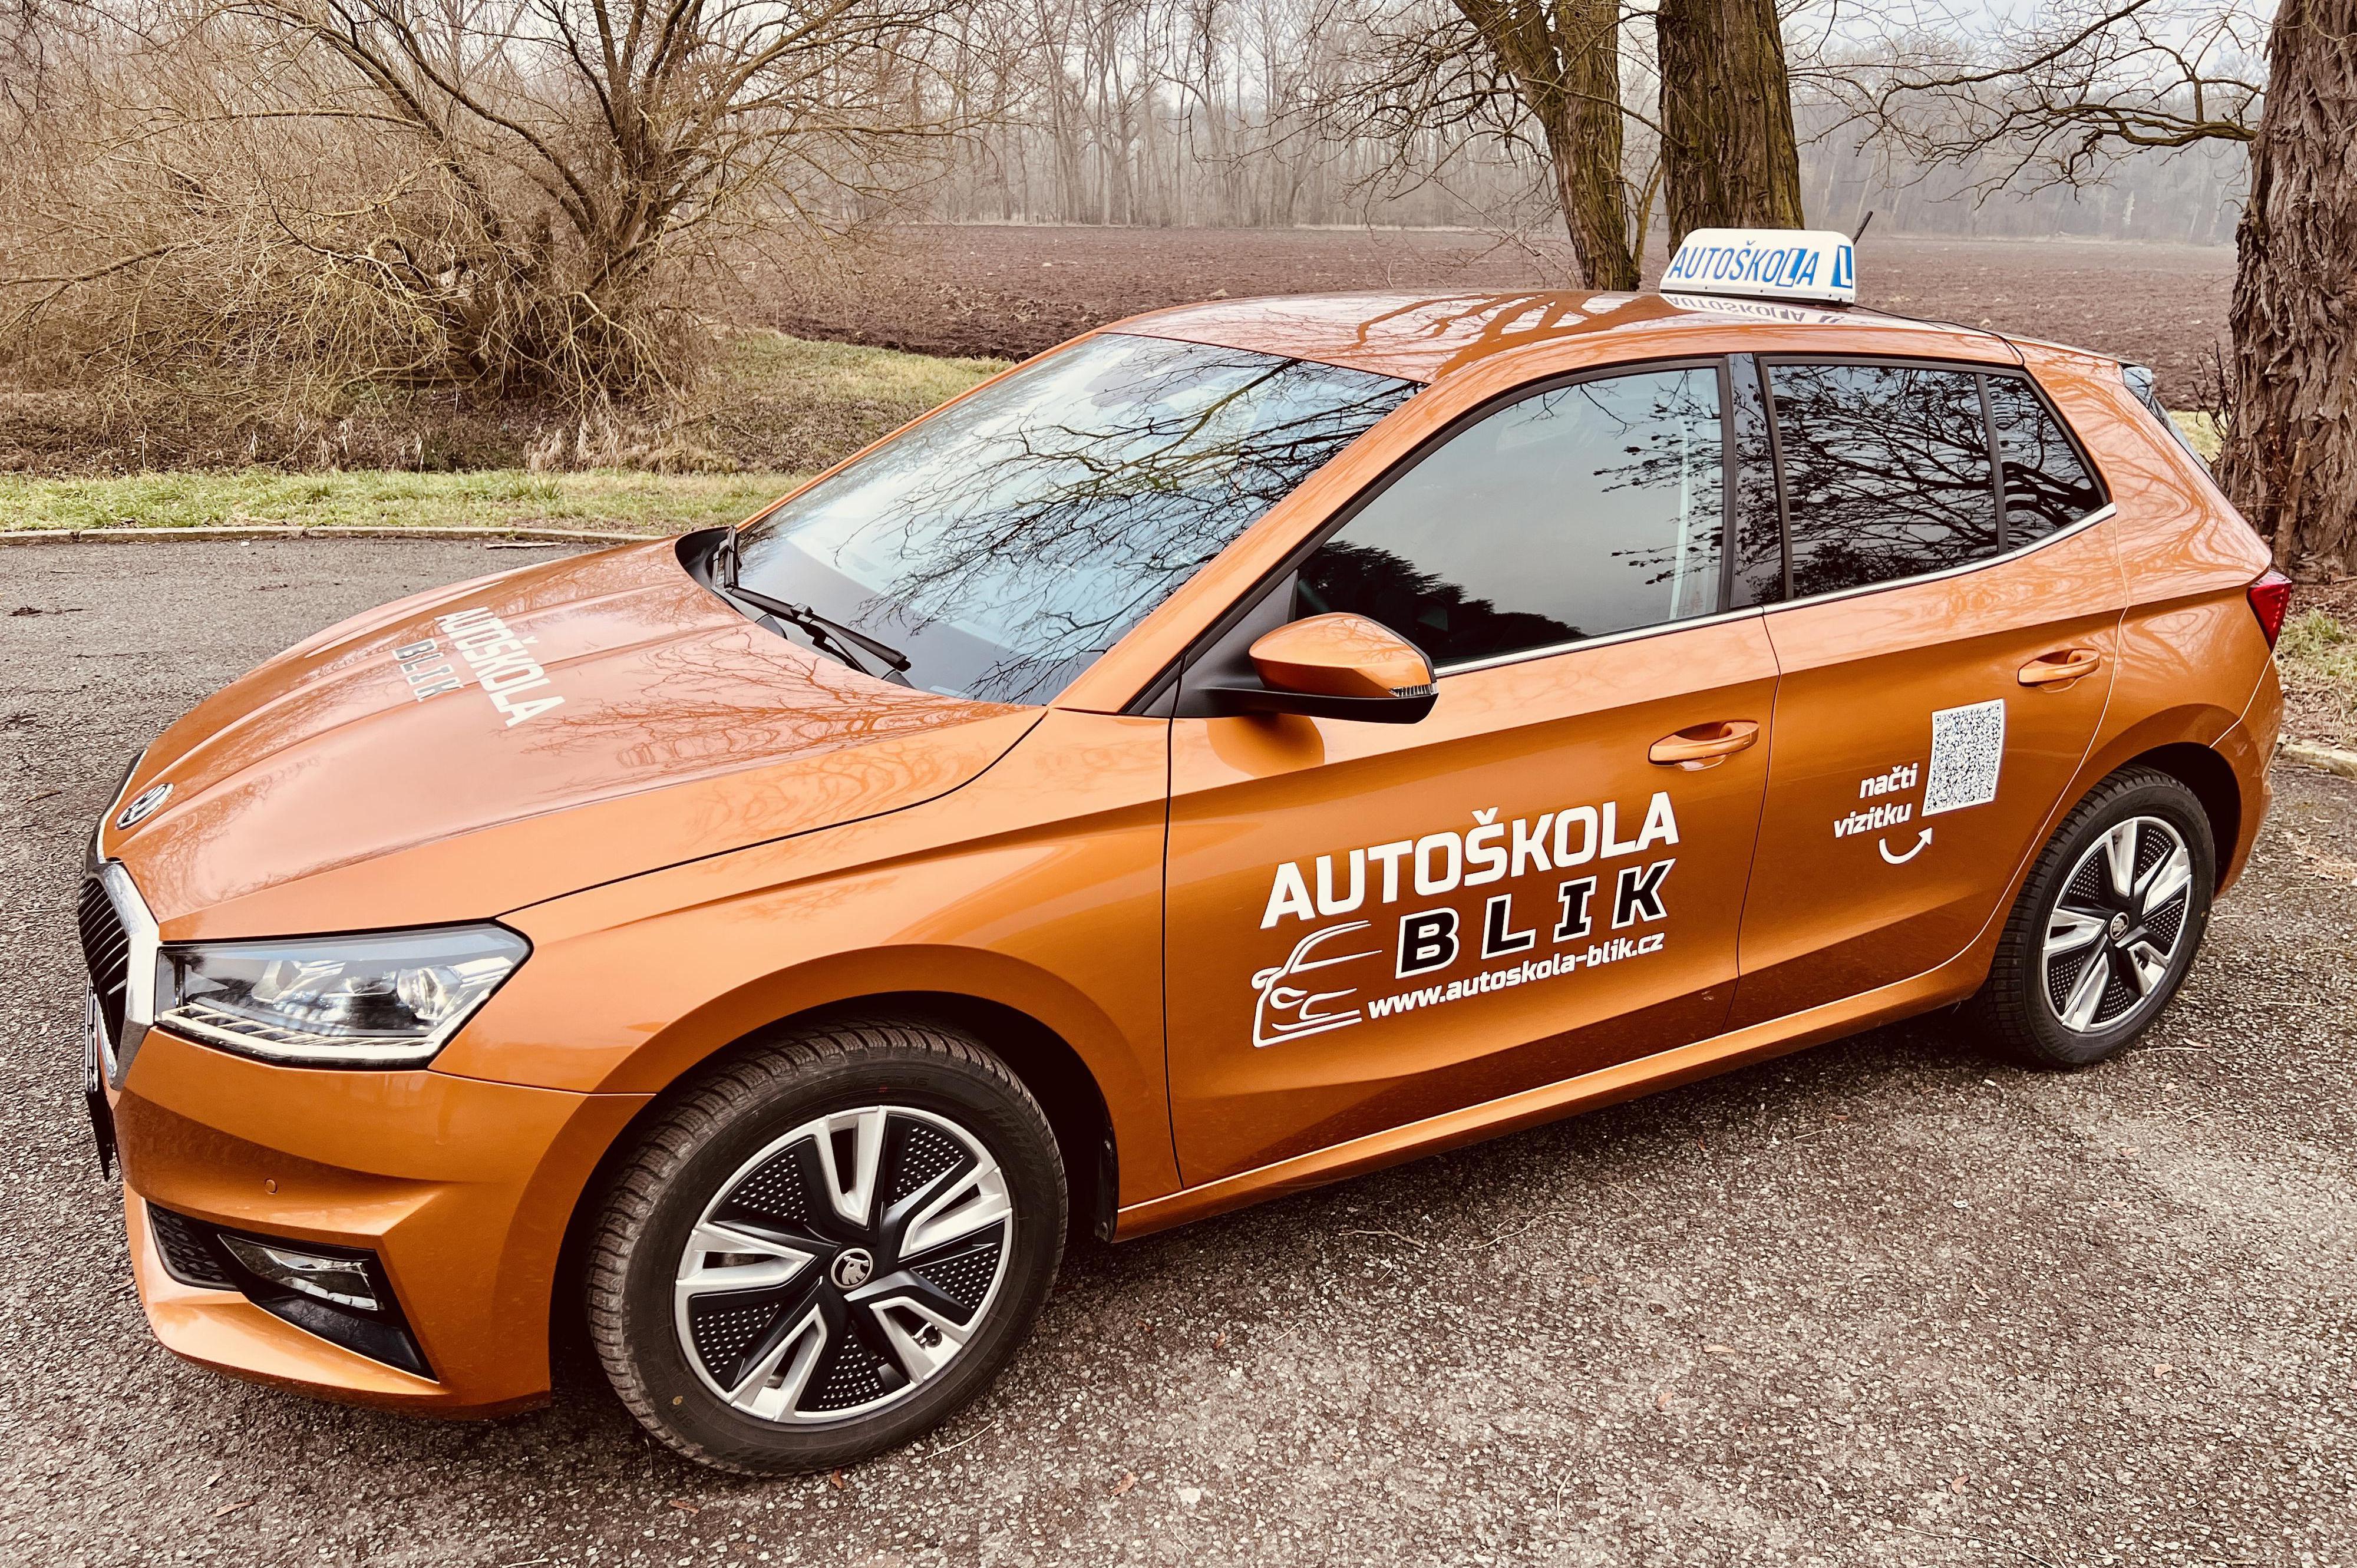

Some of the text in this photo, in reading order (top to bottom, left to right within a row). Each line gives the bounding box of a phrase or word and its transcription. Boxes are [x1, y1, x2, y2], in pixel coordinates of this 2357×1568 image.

[1668, 240, 1820, 287] AUTOŠKOLA
[392, 638, 464, 703] BLIK
[434, 606, 566, 728] AUTOŠKOLA
[1859, 762, 1919, 799] načti
[1833, 803, 1912, 839] vizitku
[1259, 791, 1679, 930] AUTOŠKOLA
[1395, 858, 1676, 979] BLIK
[1367, 932, 1665, 1019] www.autoskola-blik.cz
